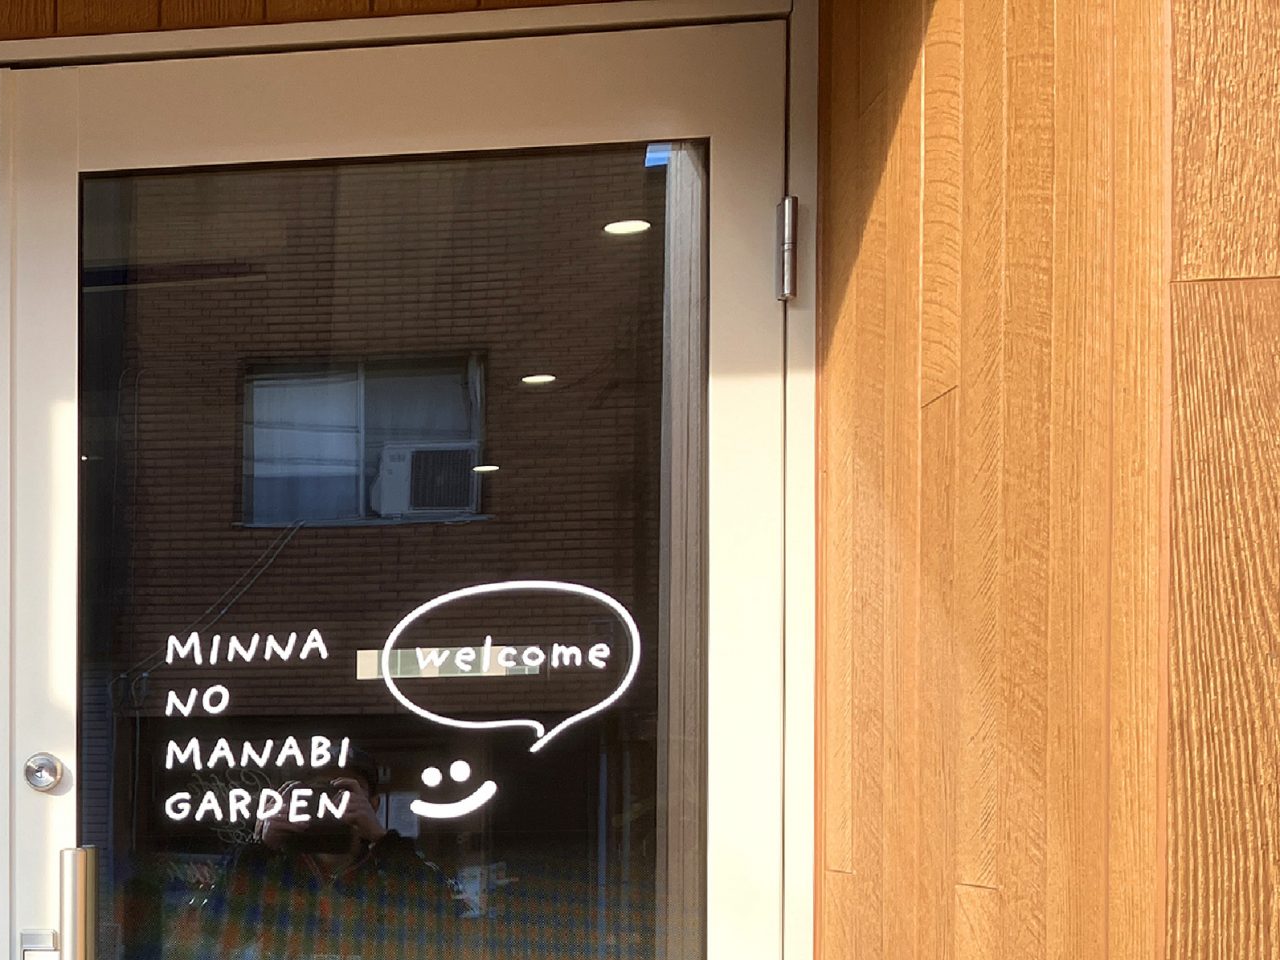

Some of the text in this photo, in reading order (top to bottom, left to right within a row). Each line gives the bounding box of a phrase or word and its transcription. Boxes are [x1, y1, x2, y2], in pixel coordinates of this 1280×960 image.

[165, 628, 329, 665] MINNA
[415, 635, 611, 673] welcome
[165, 684, 231, 717] NO
[165, 735, 350, 770] MANABI
[165, 788, 351, 823] GARDEN
